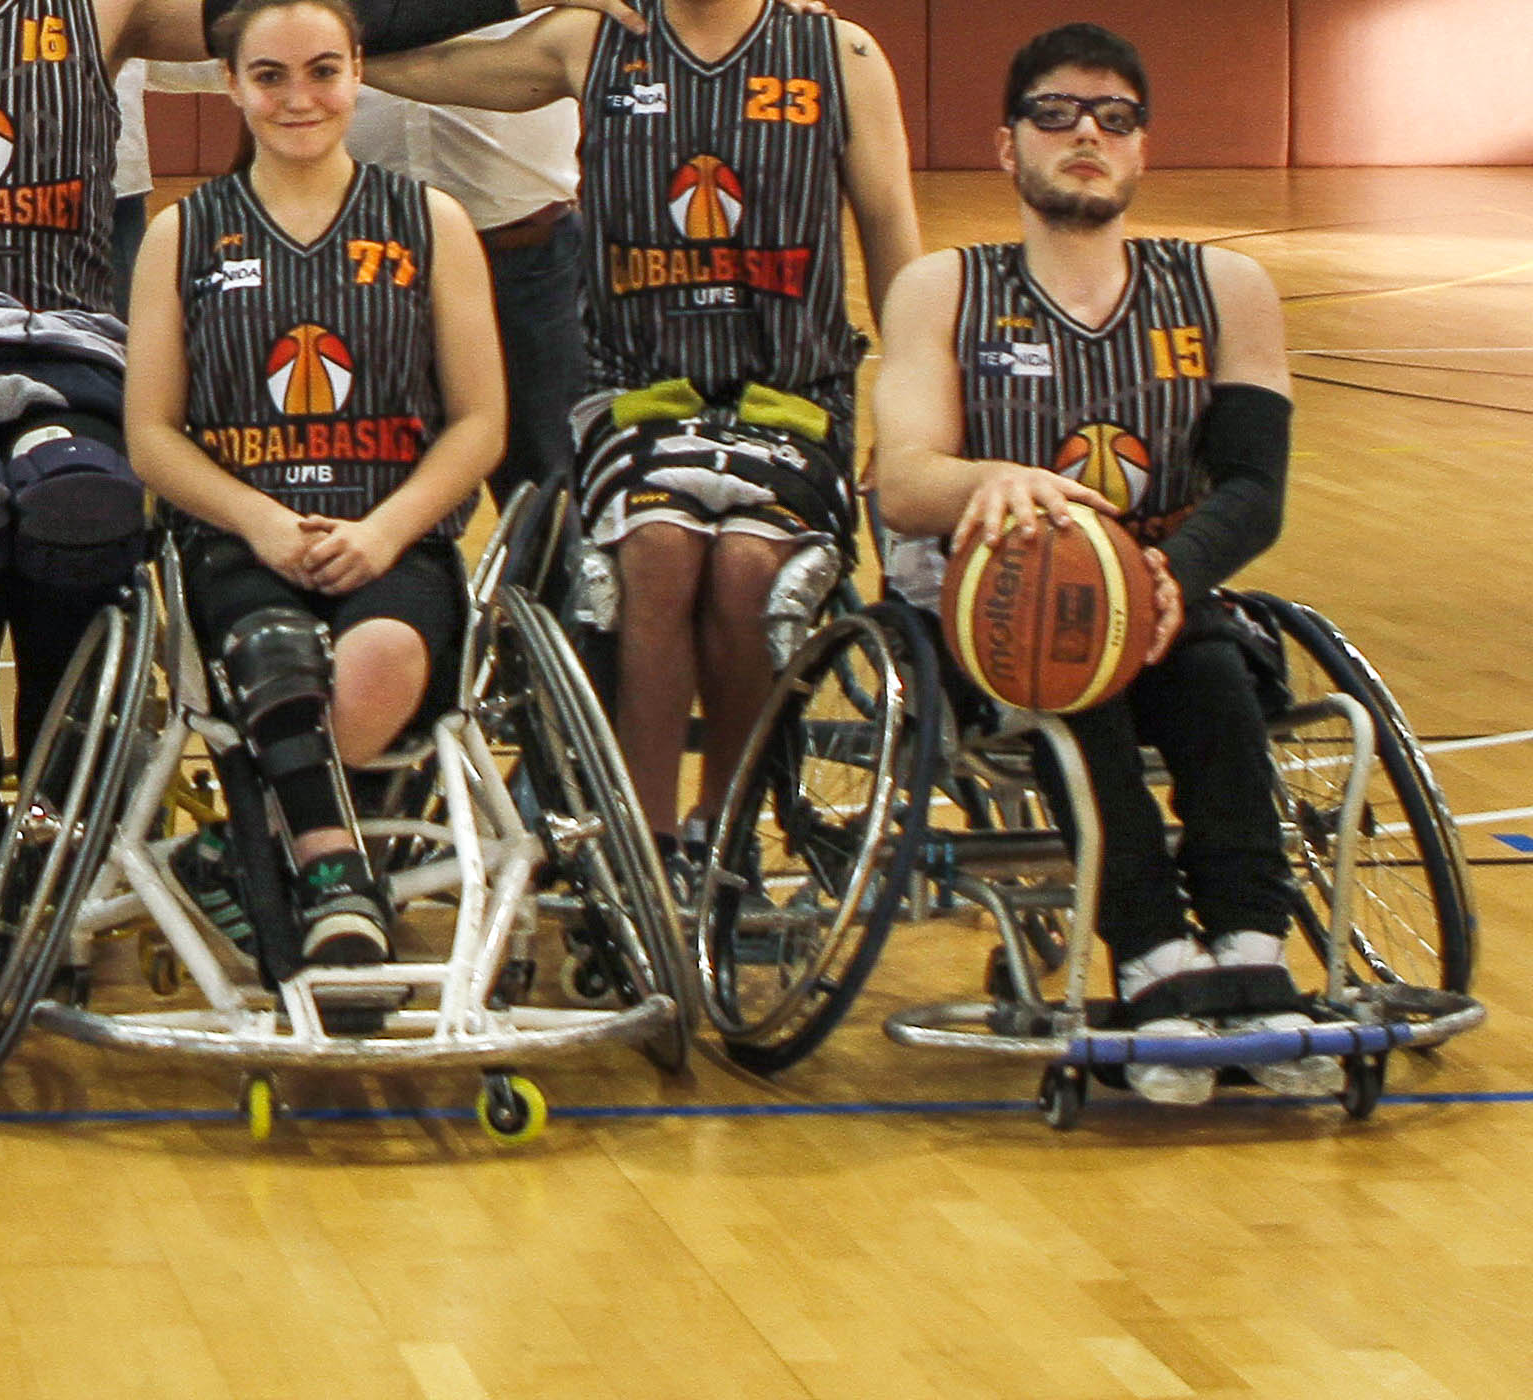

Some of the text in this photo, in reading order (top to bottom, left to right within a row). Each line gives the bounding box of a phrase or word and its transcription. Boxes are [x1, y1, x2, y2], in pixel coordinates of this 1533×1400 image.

[20, 15, 68, 62] 16
[745, 75, 822, 126] 23
[1148, 325, 1210, 380] 15
[985, 547, 1027, 680] molten
